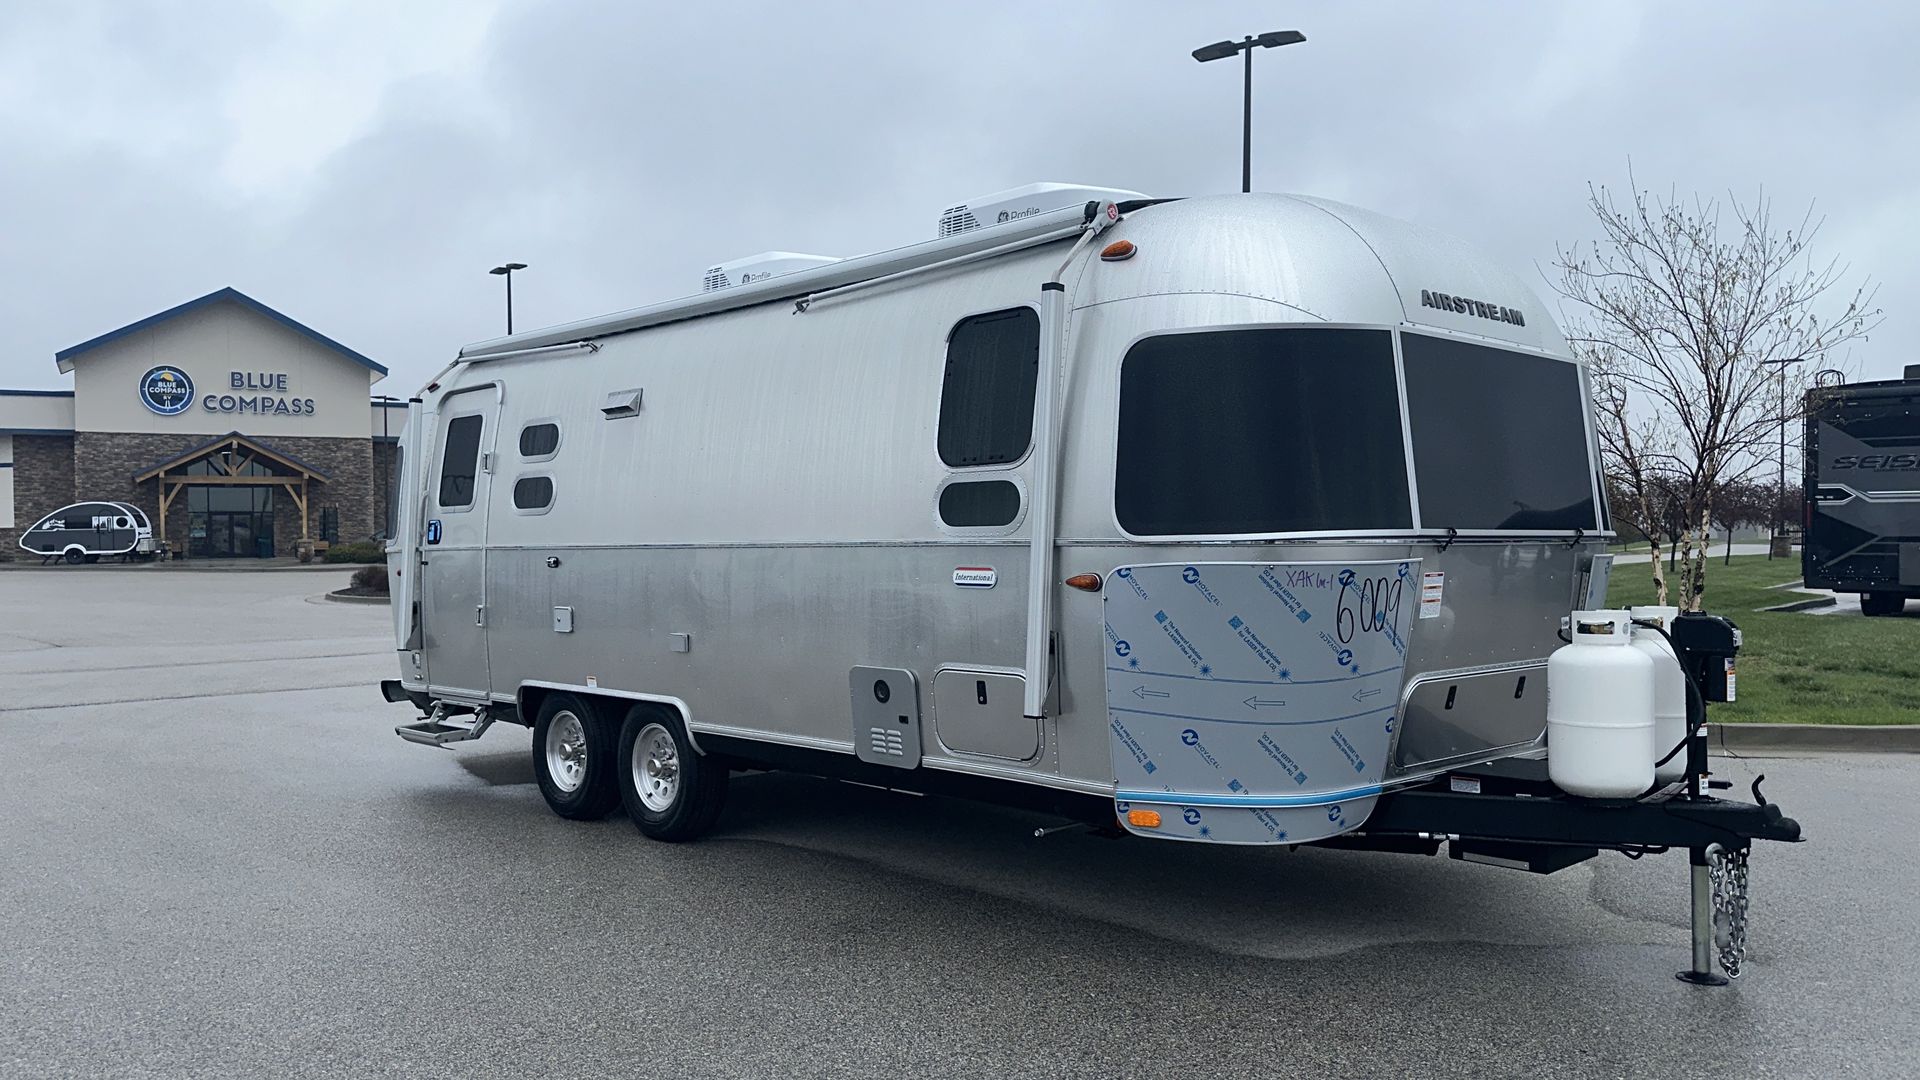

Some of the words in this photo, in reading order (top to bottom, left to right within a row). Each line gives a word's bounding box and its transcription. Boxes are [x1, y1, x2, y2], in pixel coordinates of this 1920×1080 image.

[1421, 289, 1525, 327] AIRSTREAM
[230, 371, 288, 391] BLUE
[202, 394, 316, 415] COMPASS
[1831, 454, 1920, 469] SEIS
[1129, 574, 1149, 601] NOVACEL
[1197, 580, 1221, 606] NOVACEL
[1336, 571, 1403, 647] 6009
[1319, 631, 1341, 655] NOVACEL
[1196, 742, 1221, 769] NOVACEL
